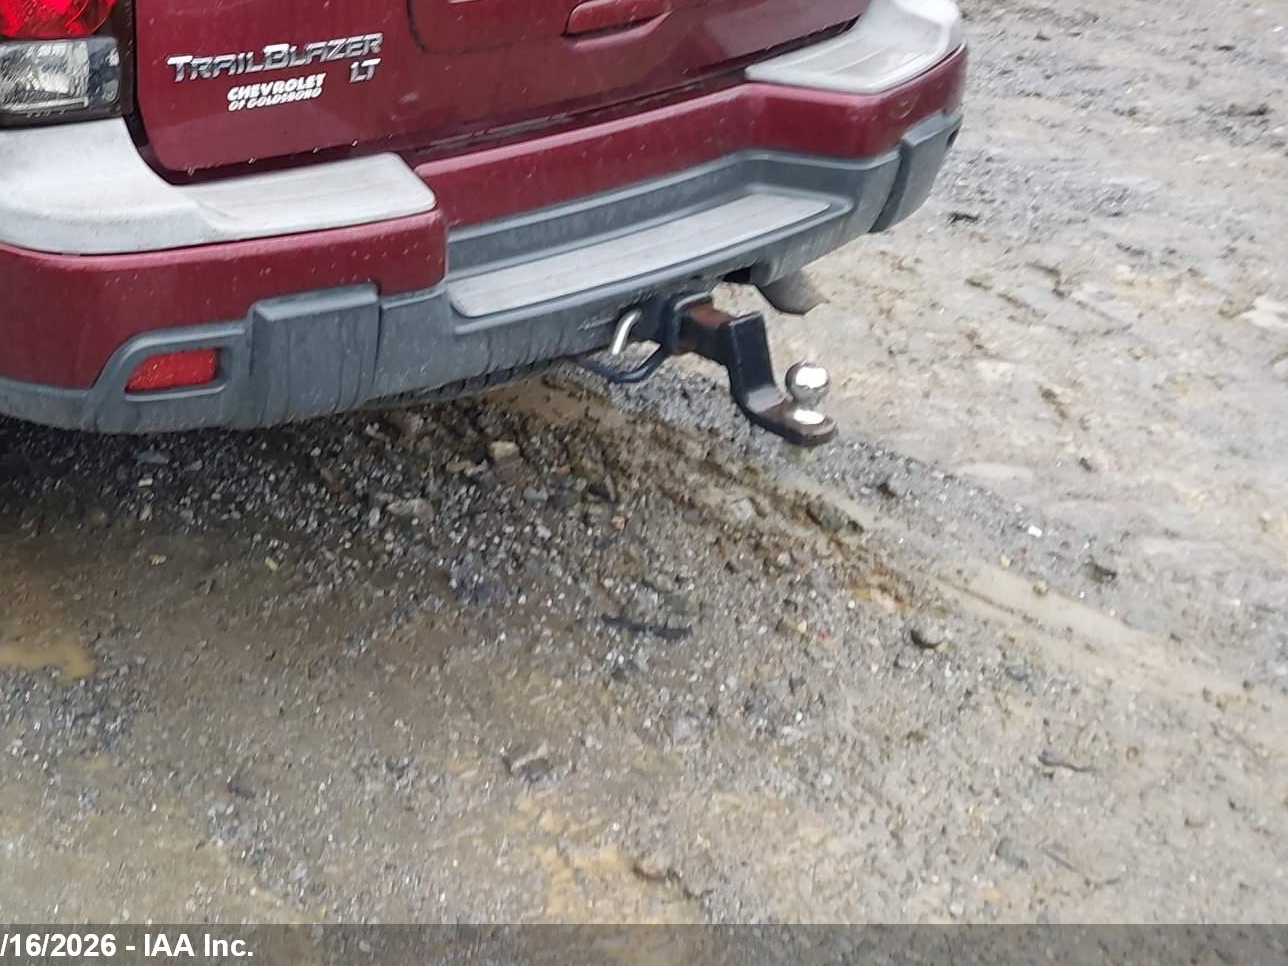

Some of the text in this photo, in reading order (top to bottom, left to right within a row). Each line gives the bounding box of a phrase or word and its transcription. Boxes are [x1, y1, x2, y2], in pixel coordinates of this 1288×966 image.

[349, 57, 381, 83] LT
[227, 73, 326, 102] CHEVROLET
[228, 87, 322, 111] OF GOLDSBORO
